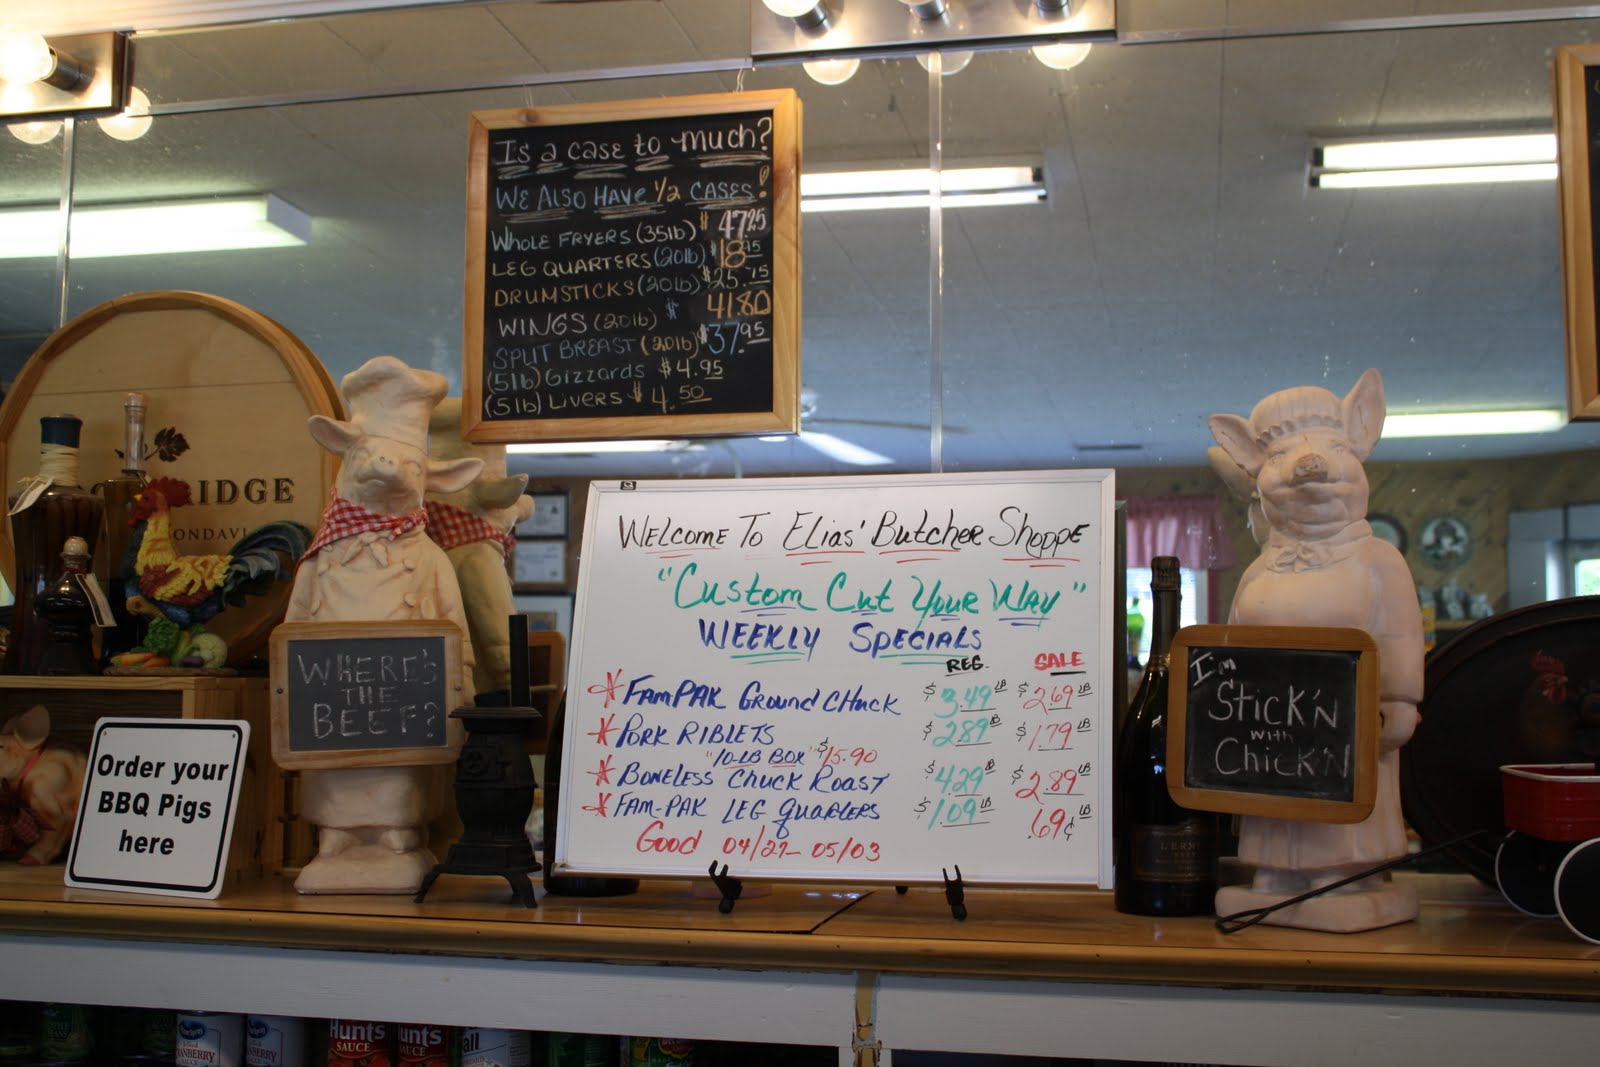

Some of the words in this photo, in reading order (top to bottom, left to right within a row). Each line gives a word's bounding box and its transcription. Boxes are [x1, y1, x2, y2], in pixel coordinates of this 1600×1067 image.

[495, 139, 531, 165] Is
[541, 143, 557, 162] a
[567, 140, 626, 161] case
[633, 132, 661, 156] to
[671, 116, 773, 152] much?
[496, 184, 529, 211] WE
[558, 228, 632, 248] FRYERS
[491, 260, 537, 277] LEG
[542, 252, 652, 278] QUARTERS
[494, 280, 634, 307] DRUMSTICKS
[498, 311, 588, 337] WINGS
[491, 343, 551, 371] SPLIT
[559, 337, 637, 360] BREAST
[186, 477, 296, 505] IDGE
[172, 527, 246, 542] ONDAVI
[826, 571, 895, 613] Cut
[698, 617, 822, 660] WEEKLY
[848, 621, 983, 659] SPECIALS
[297, 648, 438, 686] WHERE'S
[1034, 651, 1086, 671] SALE
[340, 685, 398, 706] THE
[313, 701, 440, 740] BEEF?
[614, 712, 670, 748] PORK
[676, 720, 775, 747] RIBLETS
[97, 753, 166, 779] Order
[170, 761, 230, 786] your
[98, 790, 150, 818] BBQ
[157, 793, 212, 825] Pigs
[721, 798, 767, 824] LEG
[118, 828, 175, 856] here
[810, 837, 881, 863] 05/03
[336, 1041, 371, 1053] SAUCE
